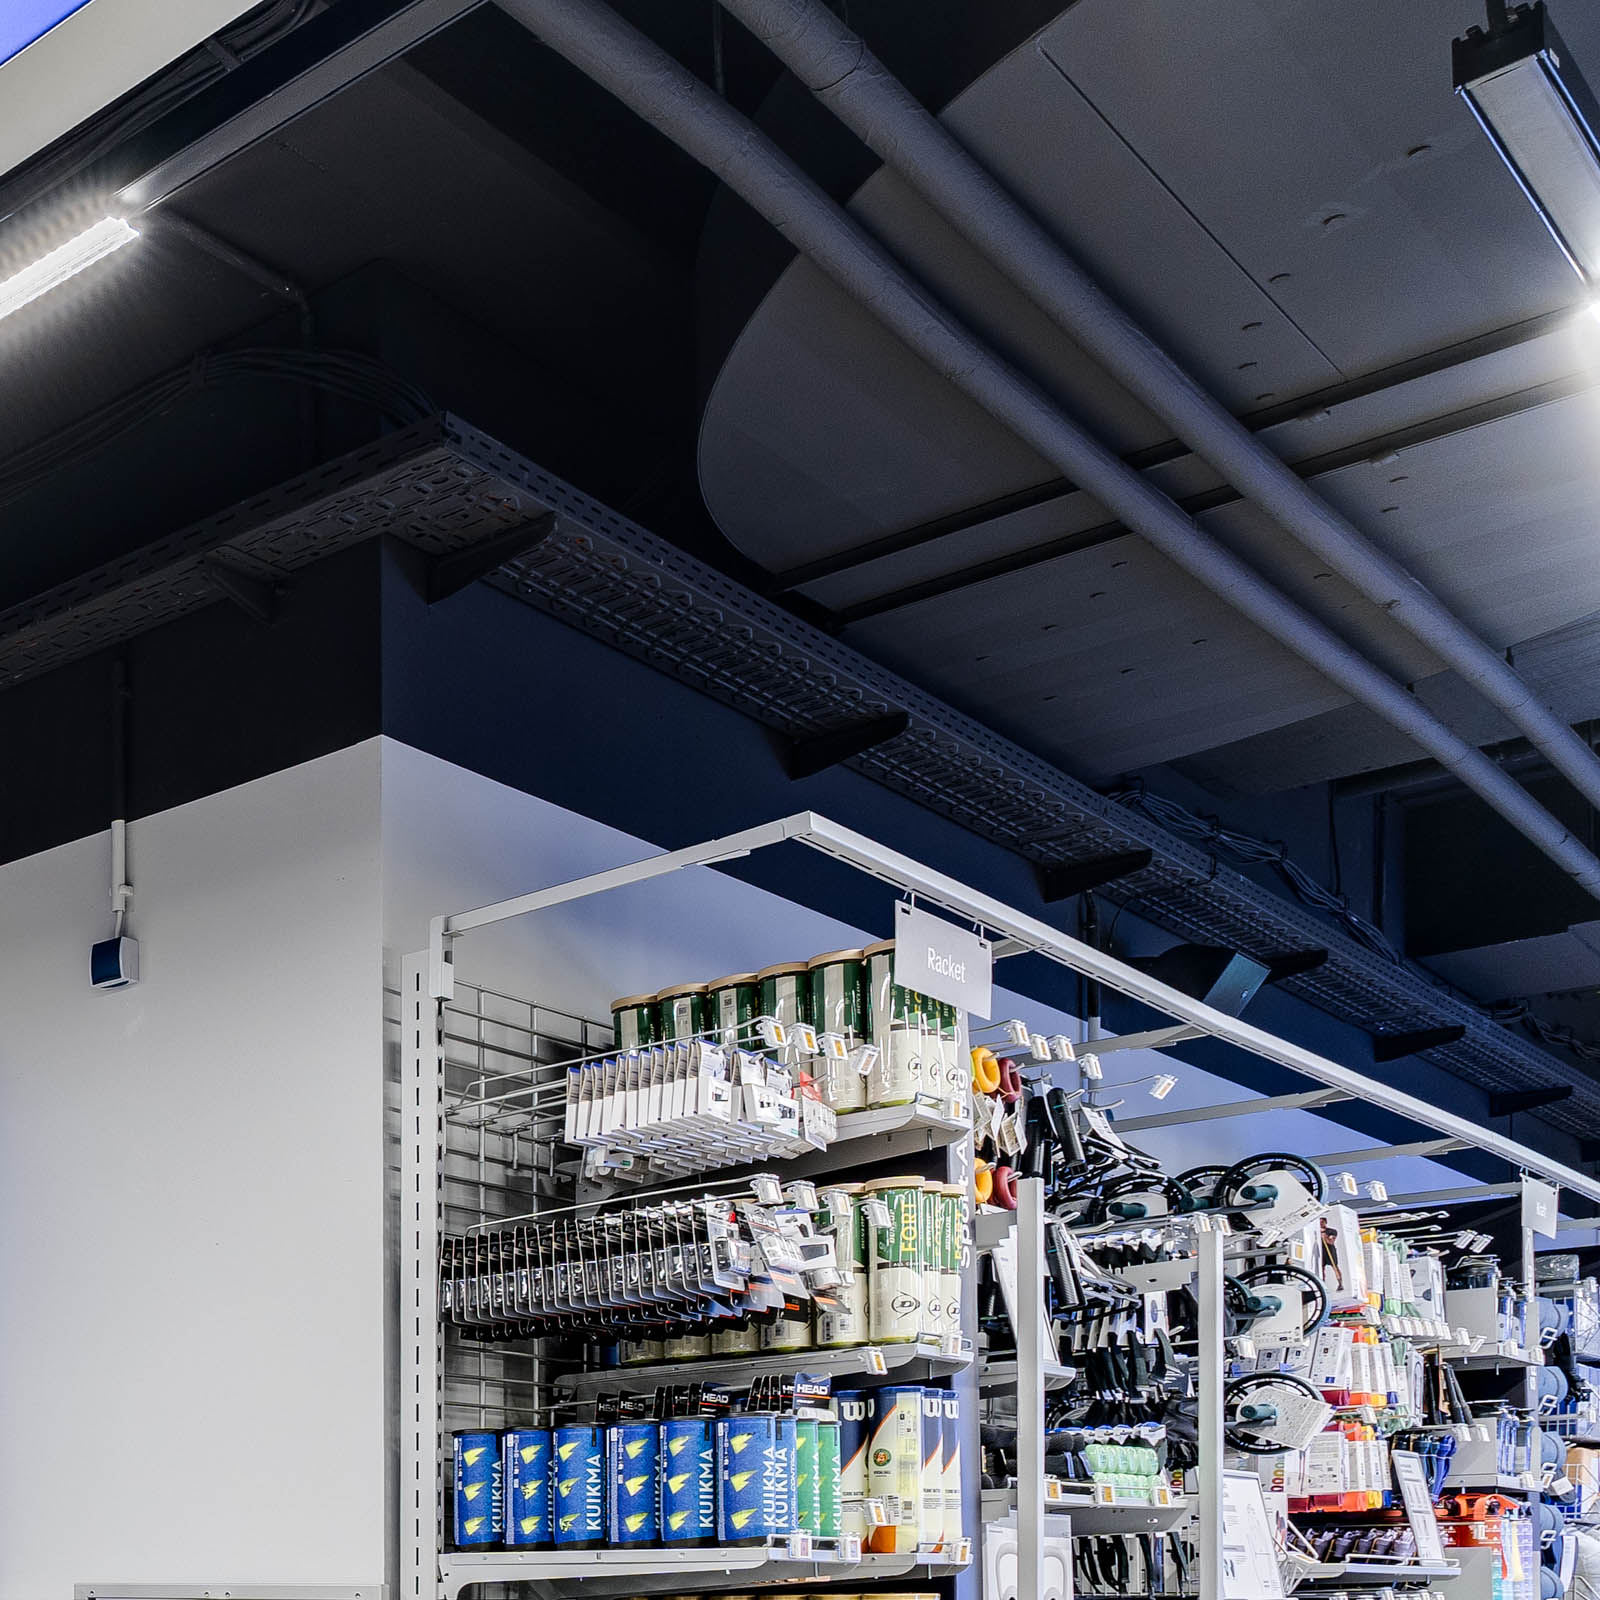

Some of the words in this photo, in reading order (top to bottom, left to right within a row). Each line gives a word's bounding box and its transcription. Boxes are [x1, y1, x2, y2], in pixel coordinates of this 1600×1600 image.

[927, 947, 966, 983] Racket
[901, 1203, 918, 1252] FORT
[620, 1400, 644, 1411] HEAD
[702, 1392, 730, 1403] HEAD
[796, 1384, 829, 1395] HEAD
[586, 1454, 601, 1530] KUIKMA
[699, 1448, 714, 1528] KUIKMA
[762, 1446, 775, 1527] KUIKMA
[775, 1447, 788, 1527] KUIKMA
